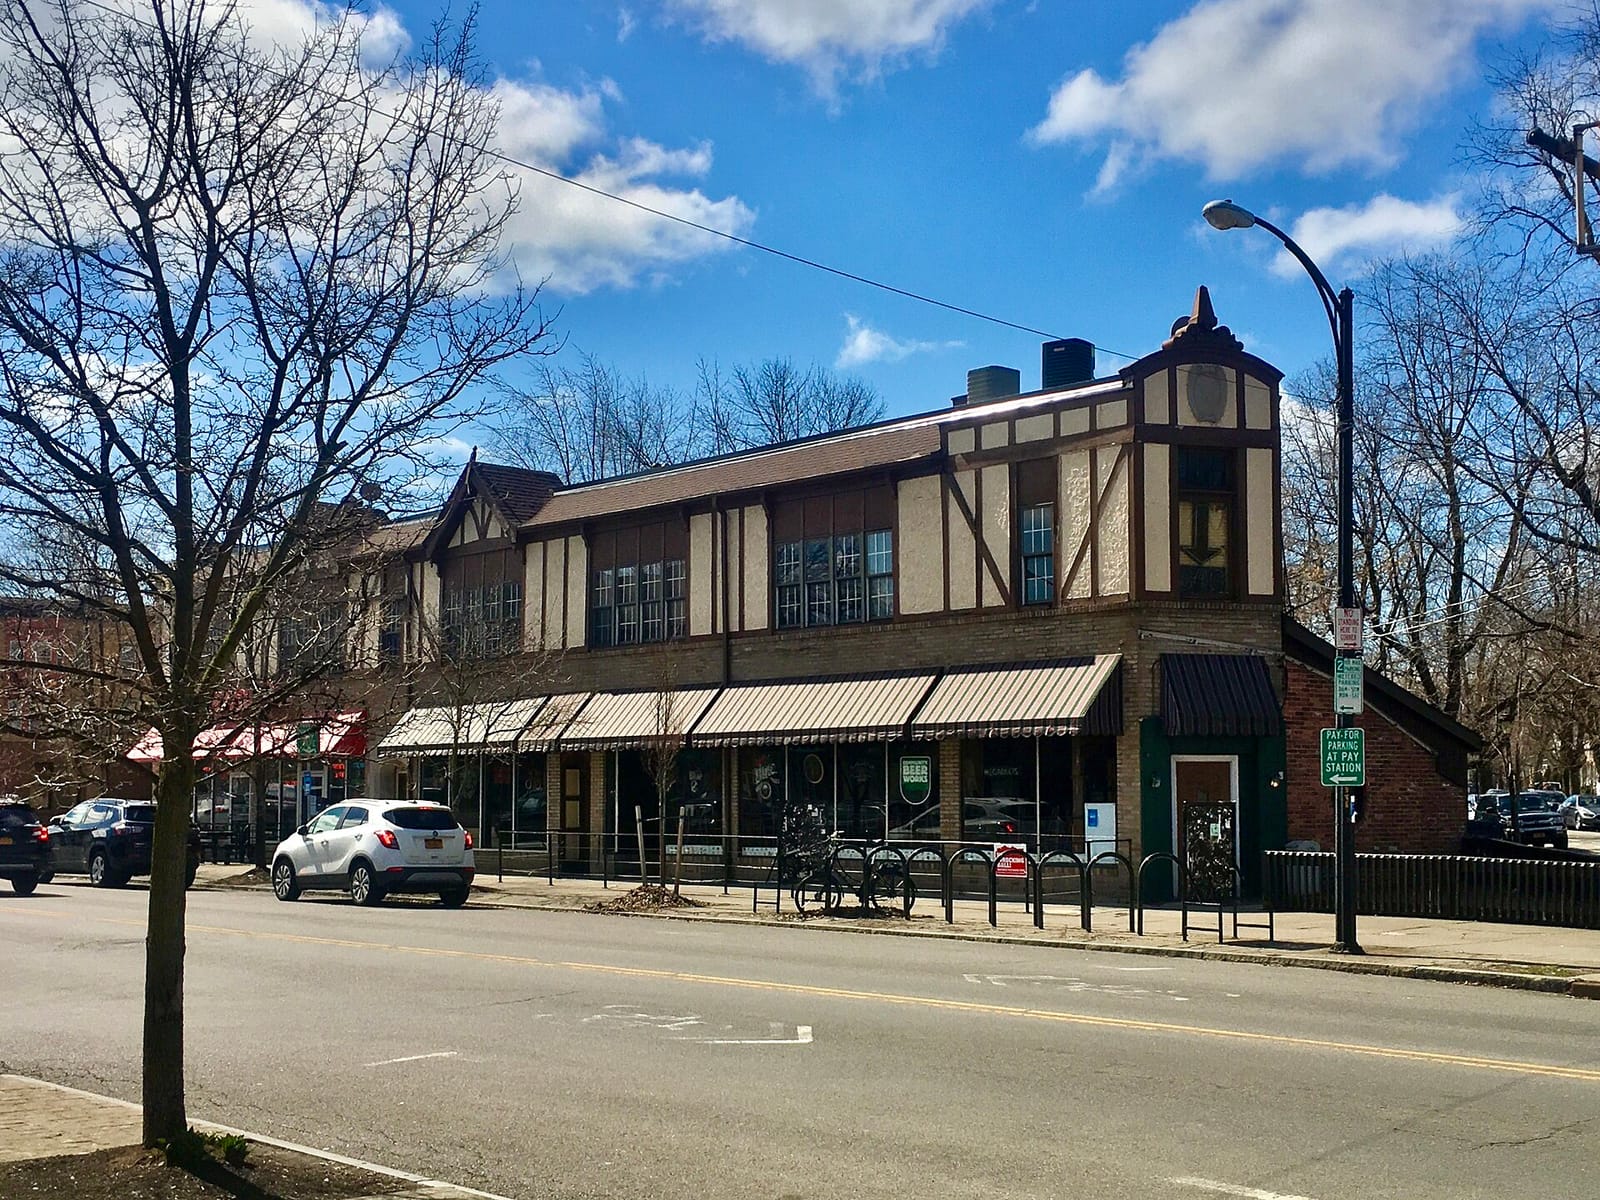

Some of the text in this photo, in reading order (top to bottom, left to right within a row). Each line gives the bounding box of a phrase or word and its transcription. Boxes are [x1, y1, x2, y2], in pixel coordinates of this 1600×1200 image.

[1343, 609, 1353, 618] NO
[1337, 660, 1343, 671] 2
[1326, 731, 1359, 739] PAY FOR
[1327, 741, 1359, 750] PARKING
[1327, 752, 1359, 761] AT PAY
[902, 765, 928, 775] BEER
[1325, 763, 1361, 772] STATION
[902, 775, 928, 783] WORKS
